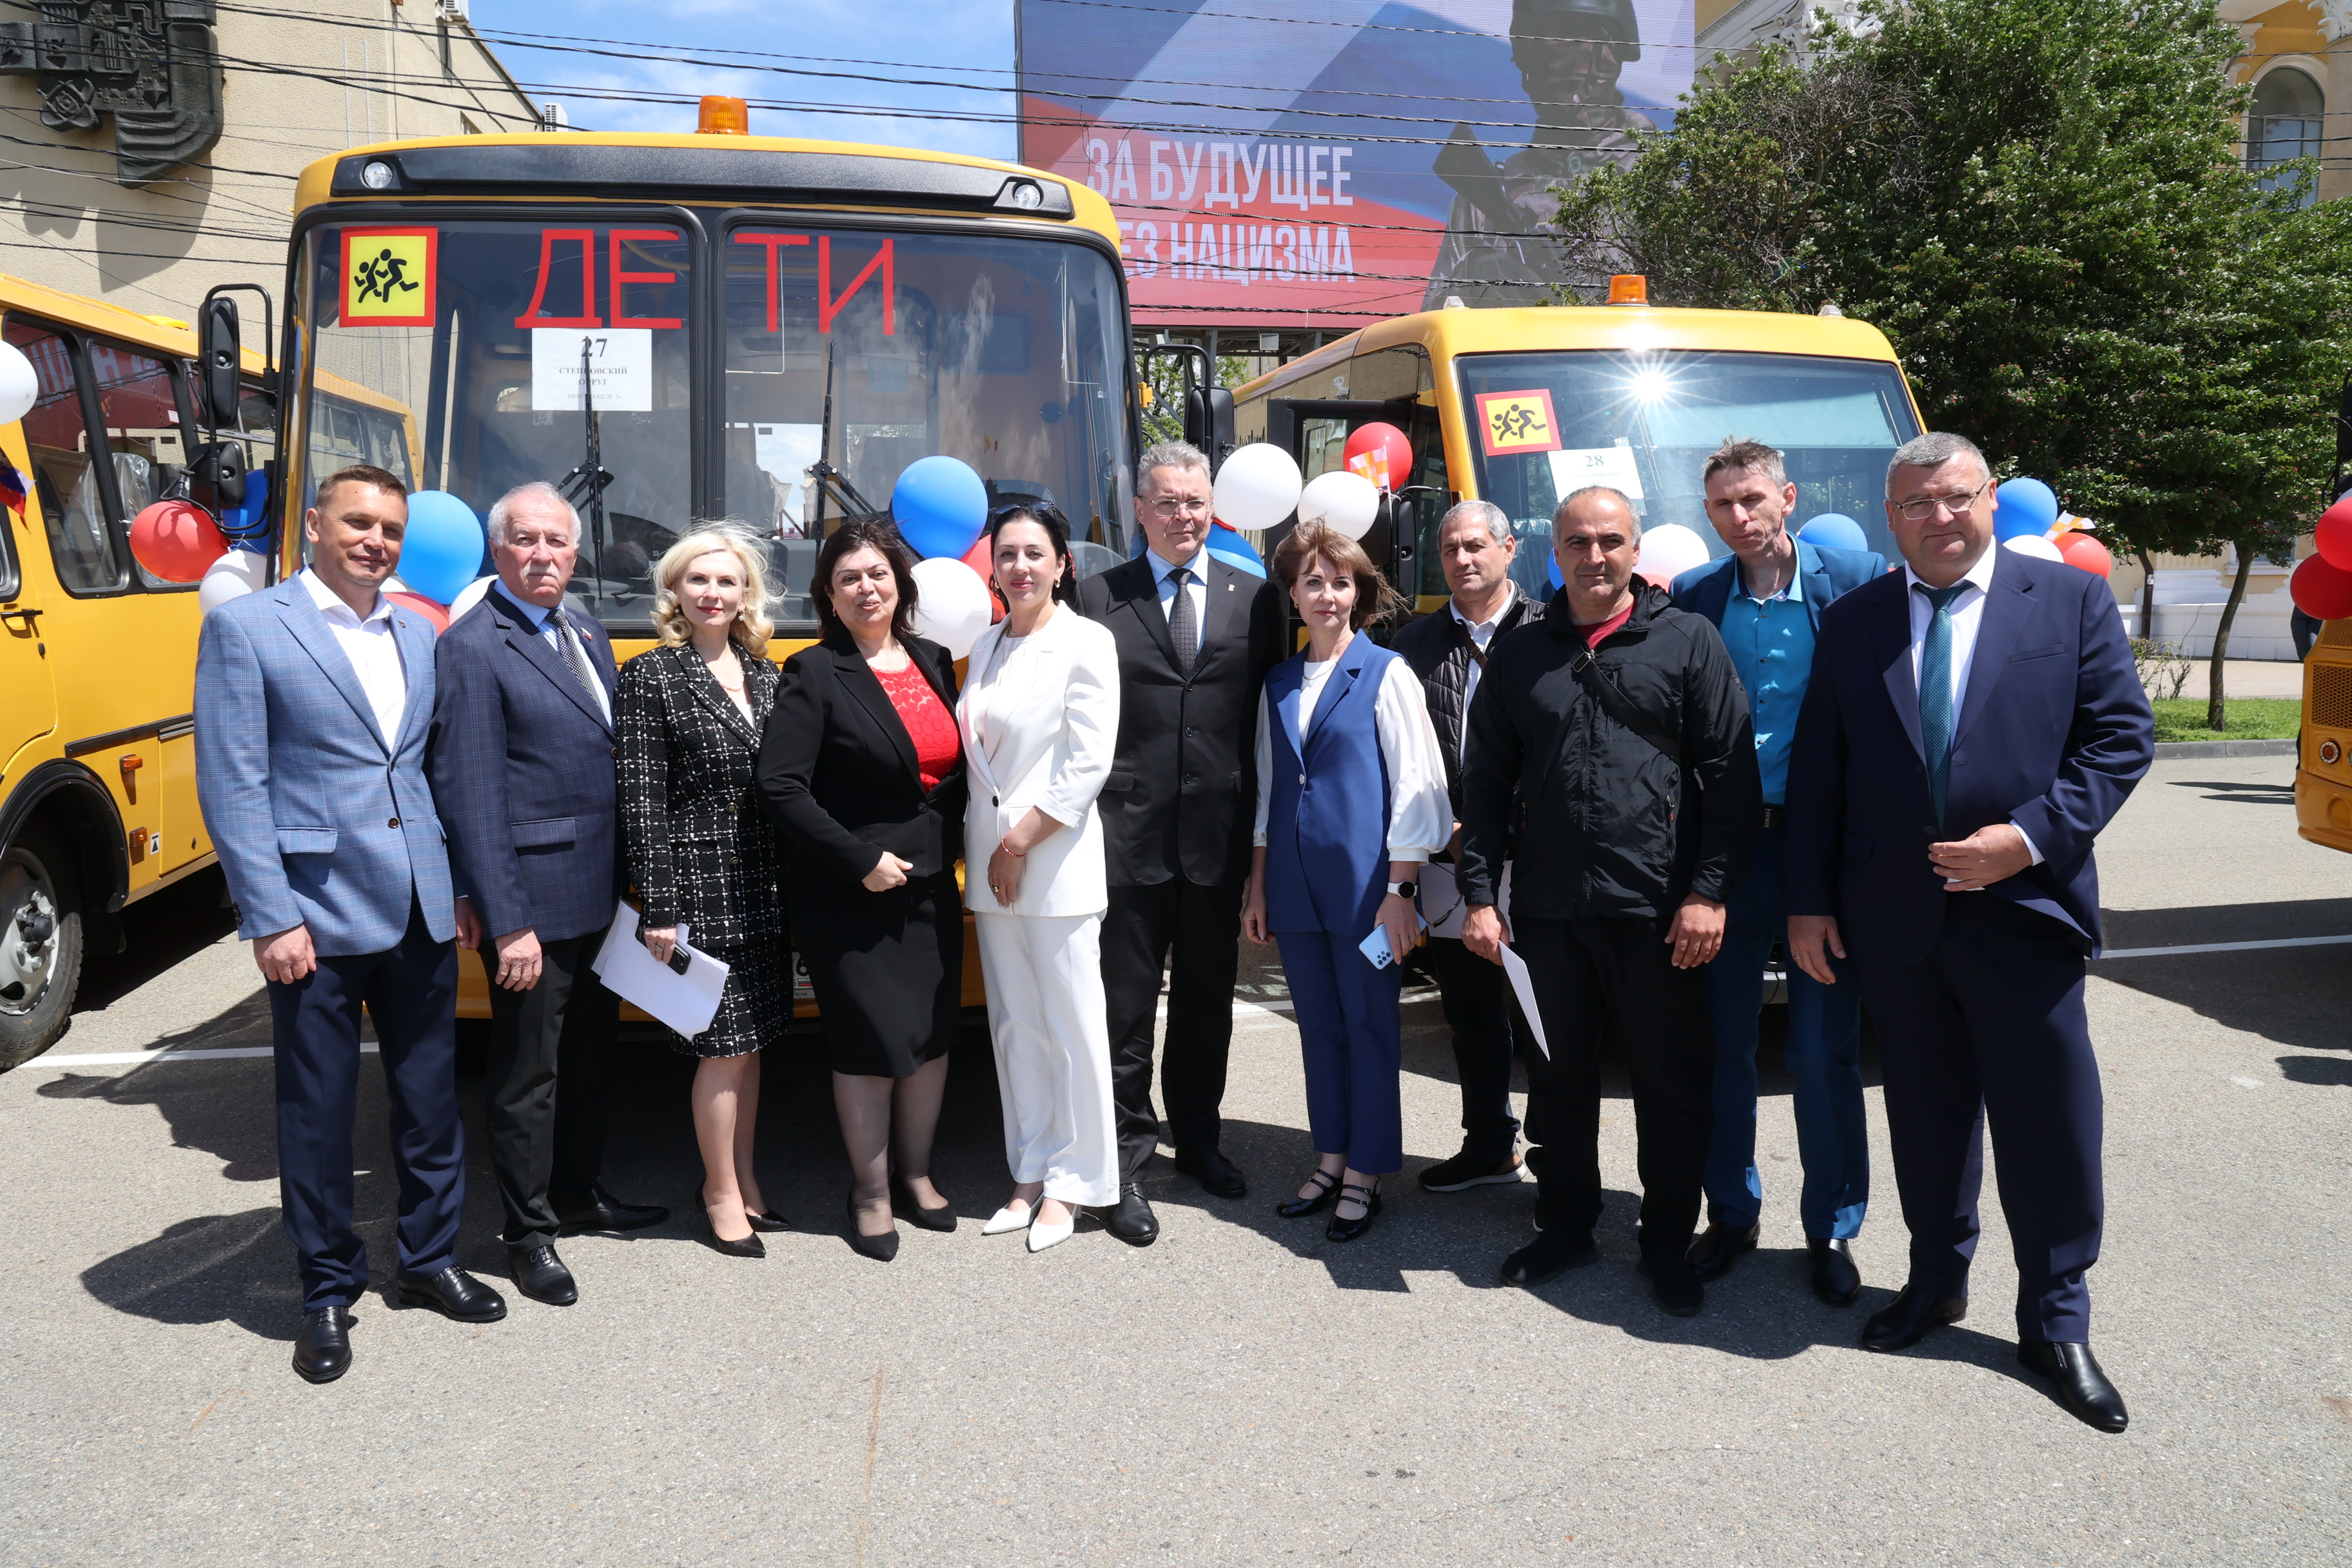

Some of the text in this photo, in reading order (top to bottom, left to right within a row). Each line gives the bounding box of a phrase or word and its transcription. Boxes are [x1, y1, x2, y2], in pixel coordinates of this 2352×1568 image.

[1086, 138, 1353, 211] ЗА БУДУЩЕЕ
[1116, 221, 1355, 286] ЕЗ НАЦИЗМА
[581, 338, 608, 358] 27
[559, 366, 627, 375] СТЕПОВСКИЙ
[1584, 454, 1604, 467] 28
